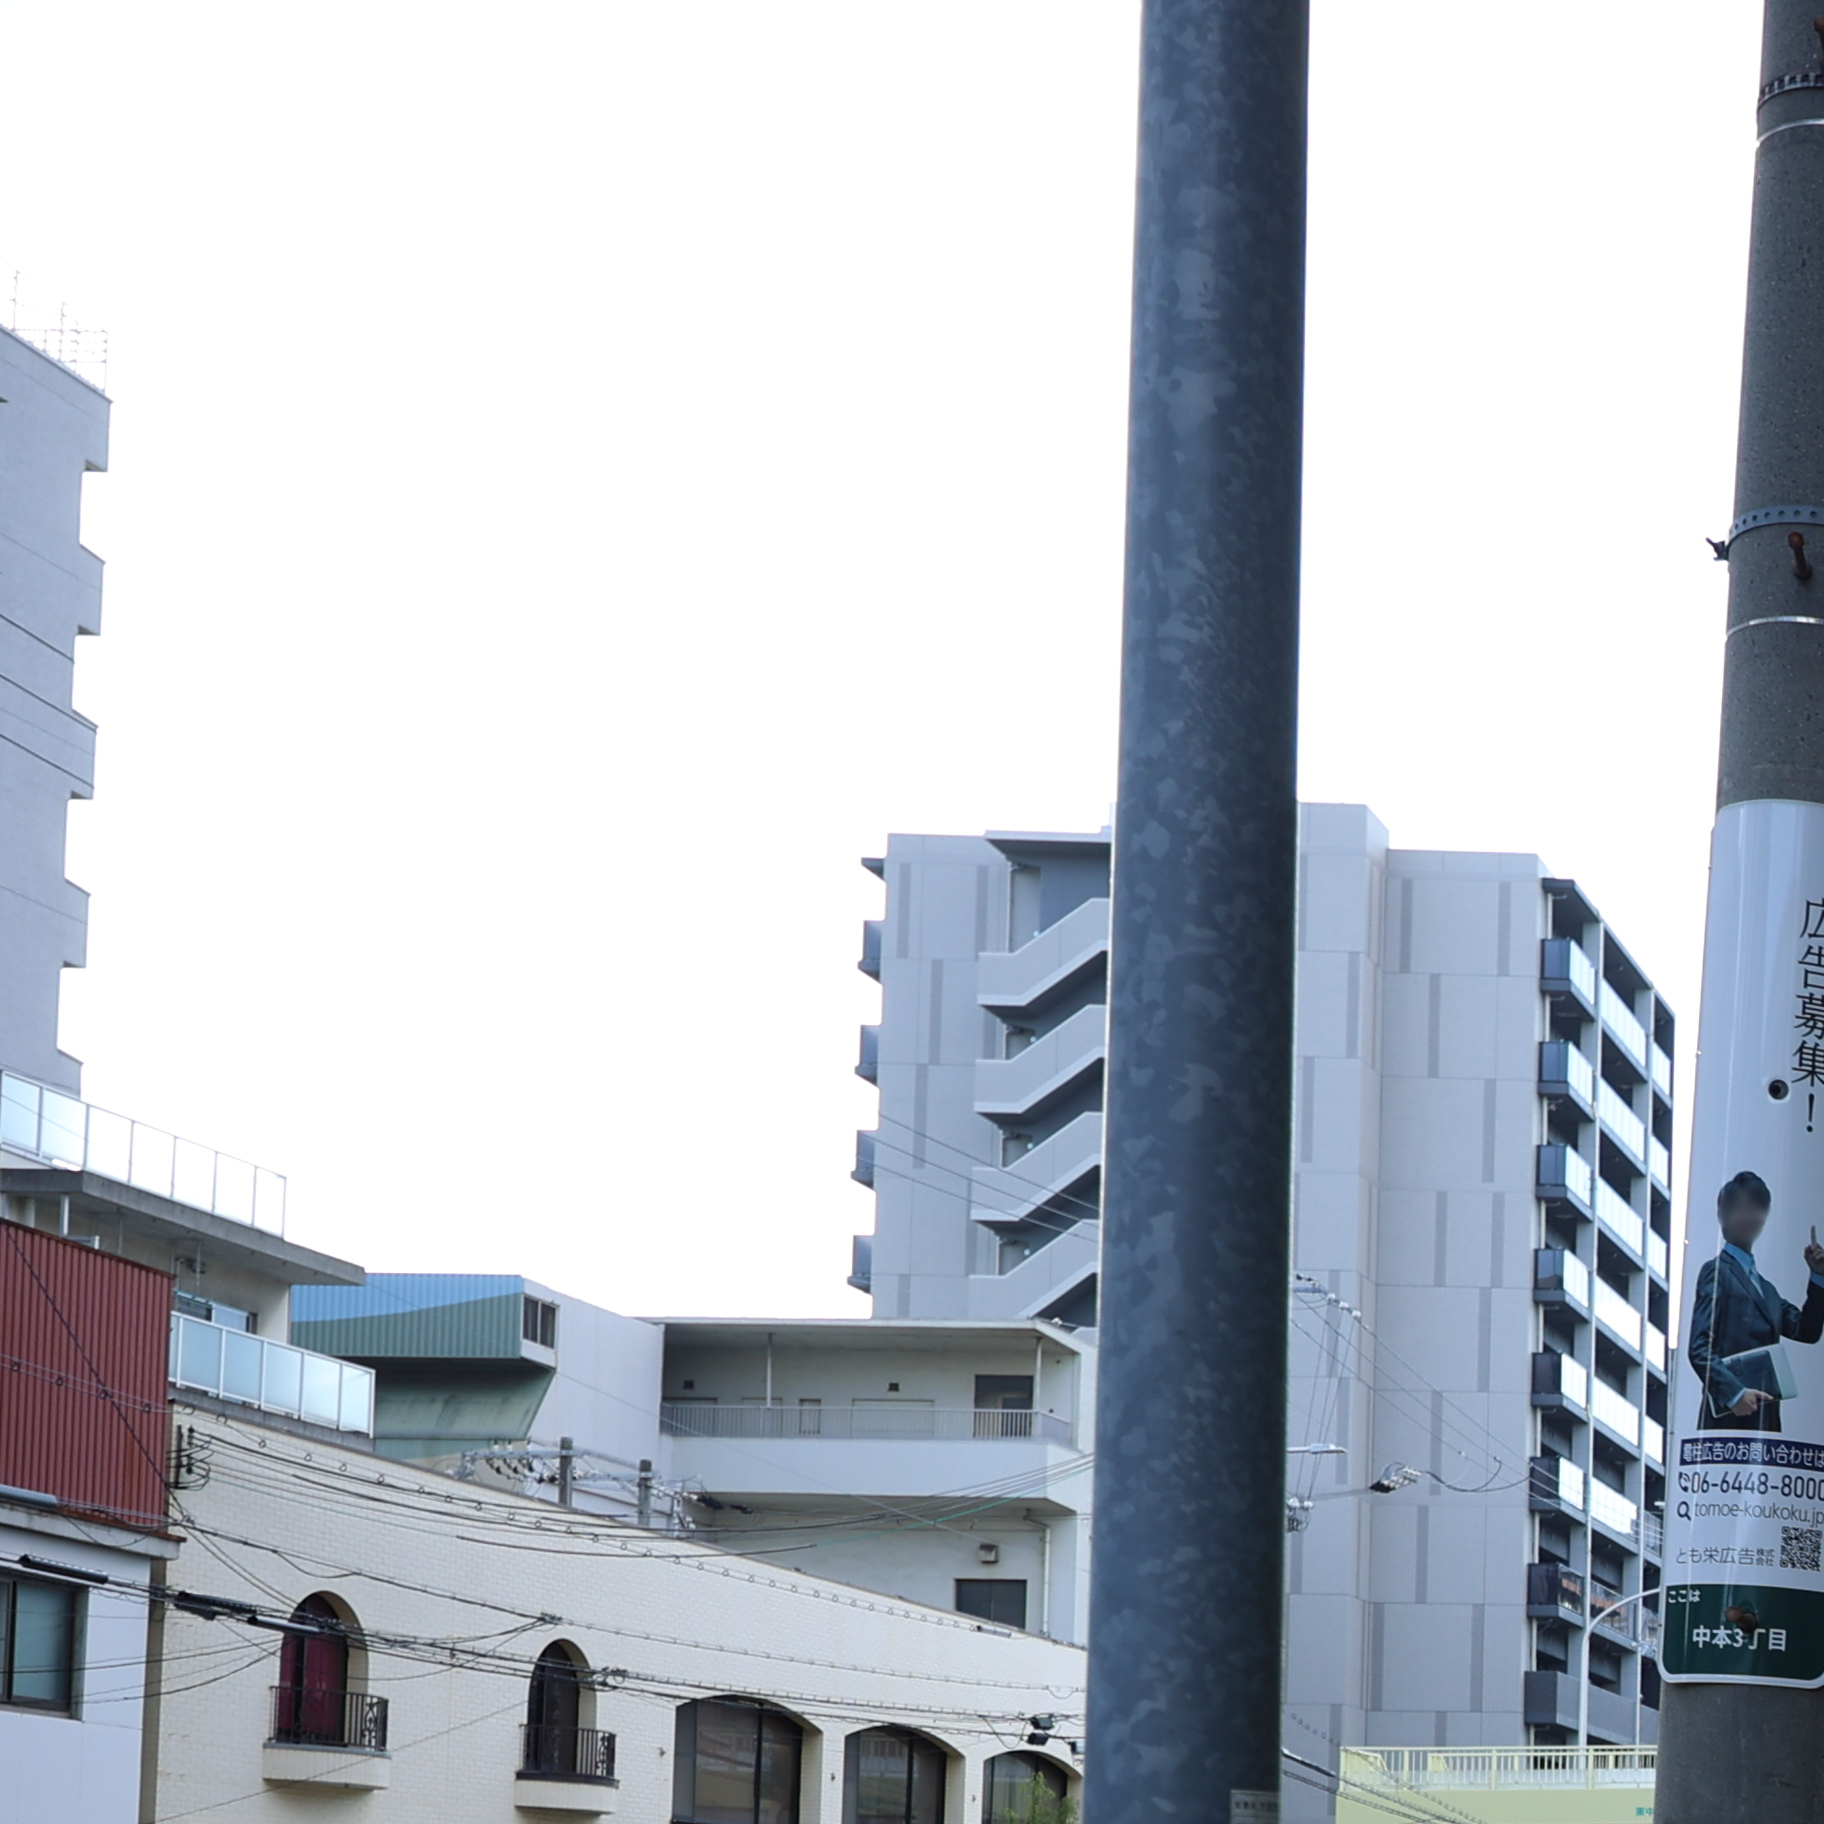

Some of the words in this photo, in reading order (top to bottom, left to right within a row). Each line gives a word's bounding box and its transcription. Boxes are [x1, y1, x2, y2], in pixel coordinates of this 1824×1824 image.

[1676, 1546, 1755, 1565] とも栄広告
[1668, 1589, 1701, 1603] ここは
[1692, 1625, 1787, 1651] 中本3丁目
